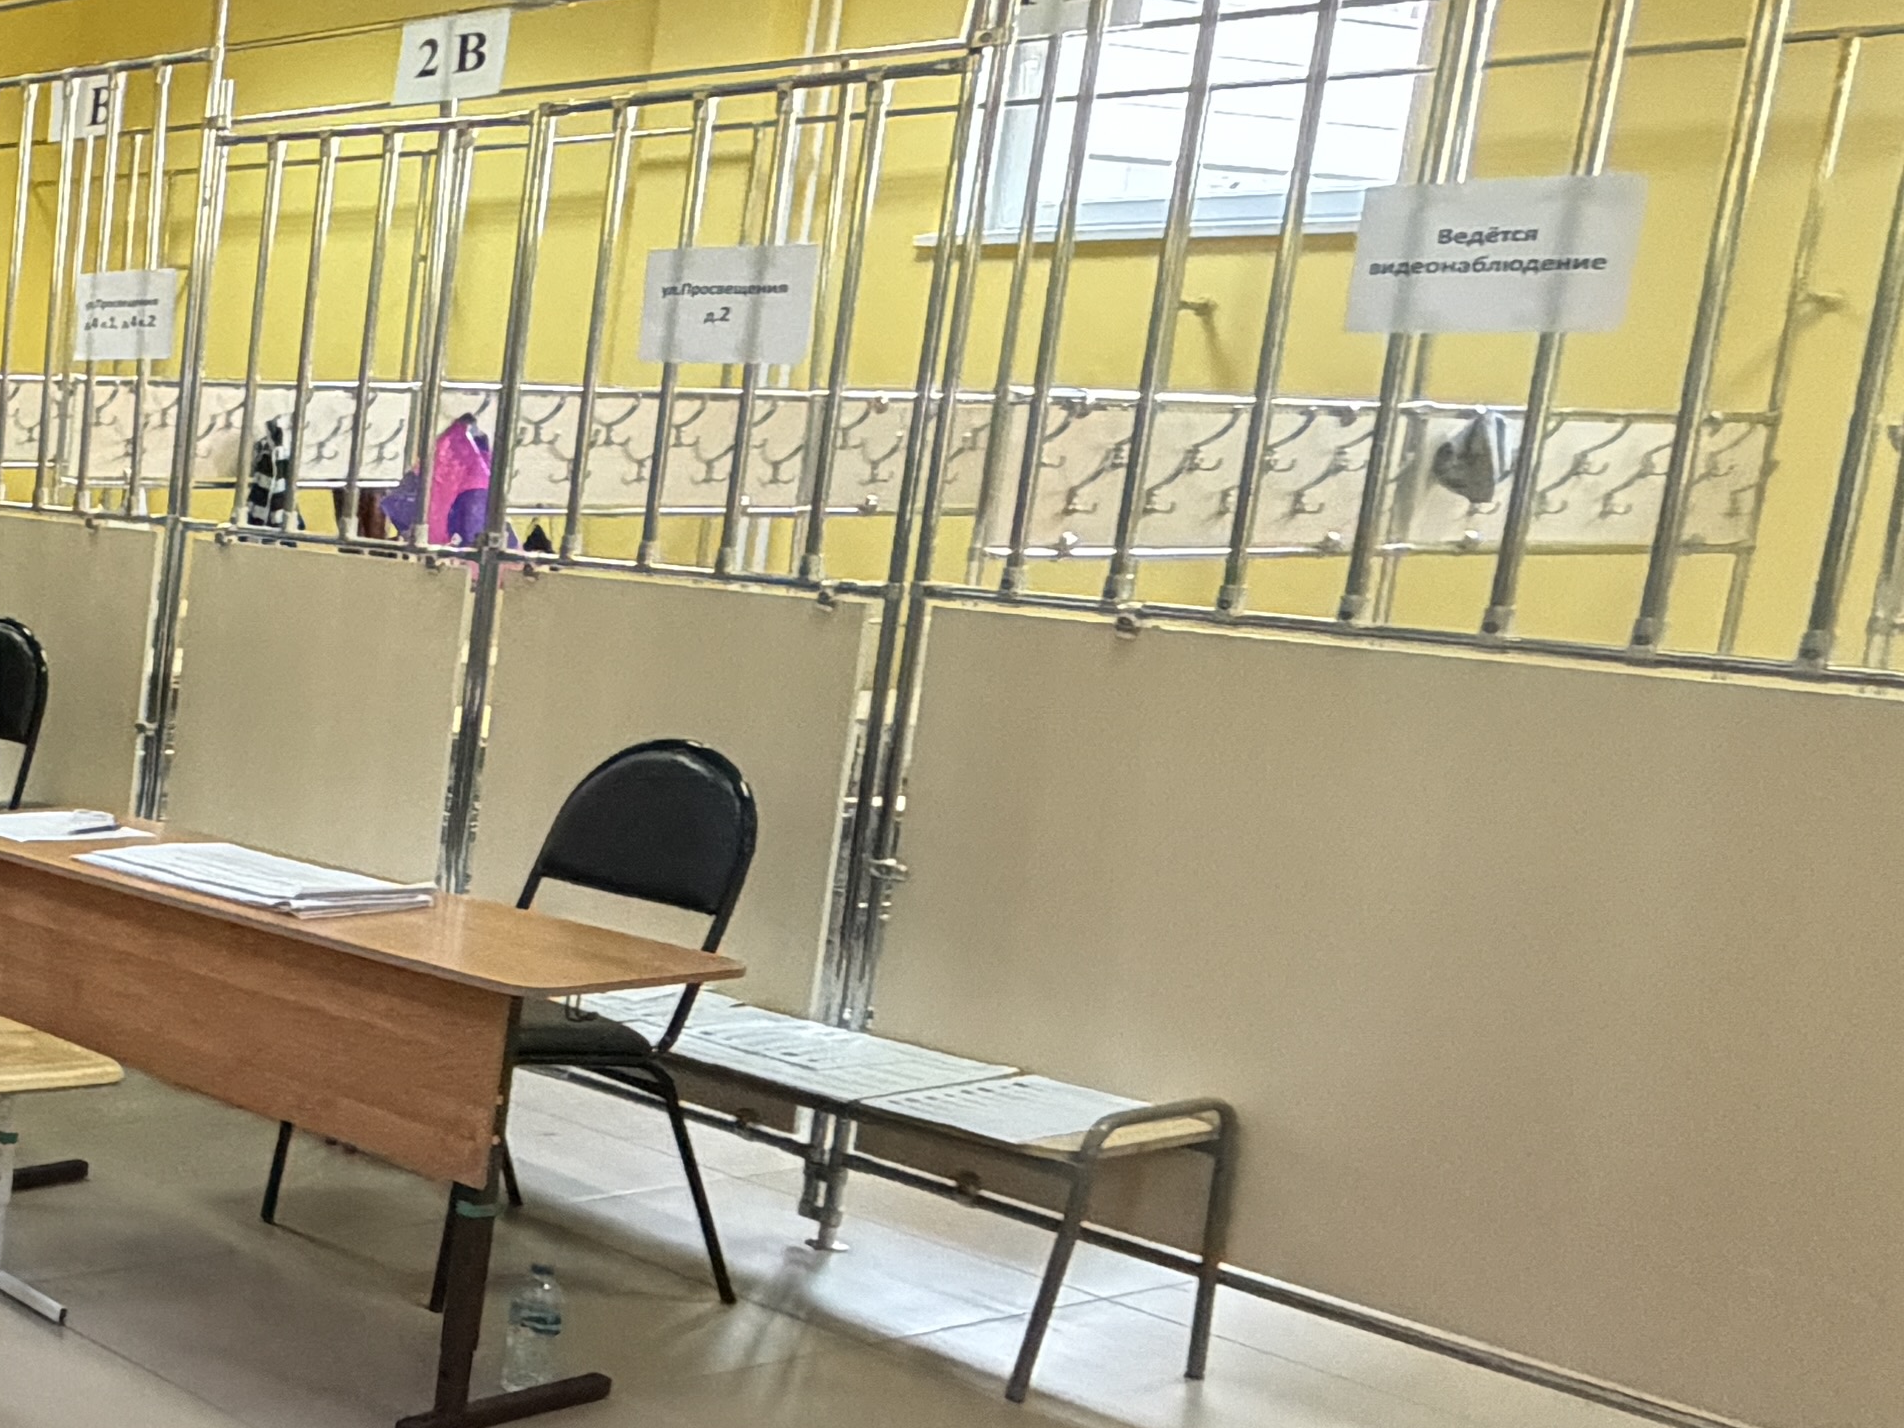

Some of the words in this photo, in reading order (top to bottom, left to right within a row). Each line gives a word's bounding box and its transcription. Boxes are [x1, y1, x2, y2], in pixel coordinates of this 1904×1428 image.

[414, 37, 439, 79] 2
[452, 31, 487, 75] В
[1437, 226, 1539, 247] Ведётся
[1368, 254, 1608, 276] видеонаблюдение
